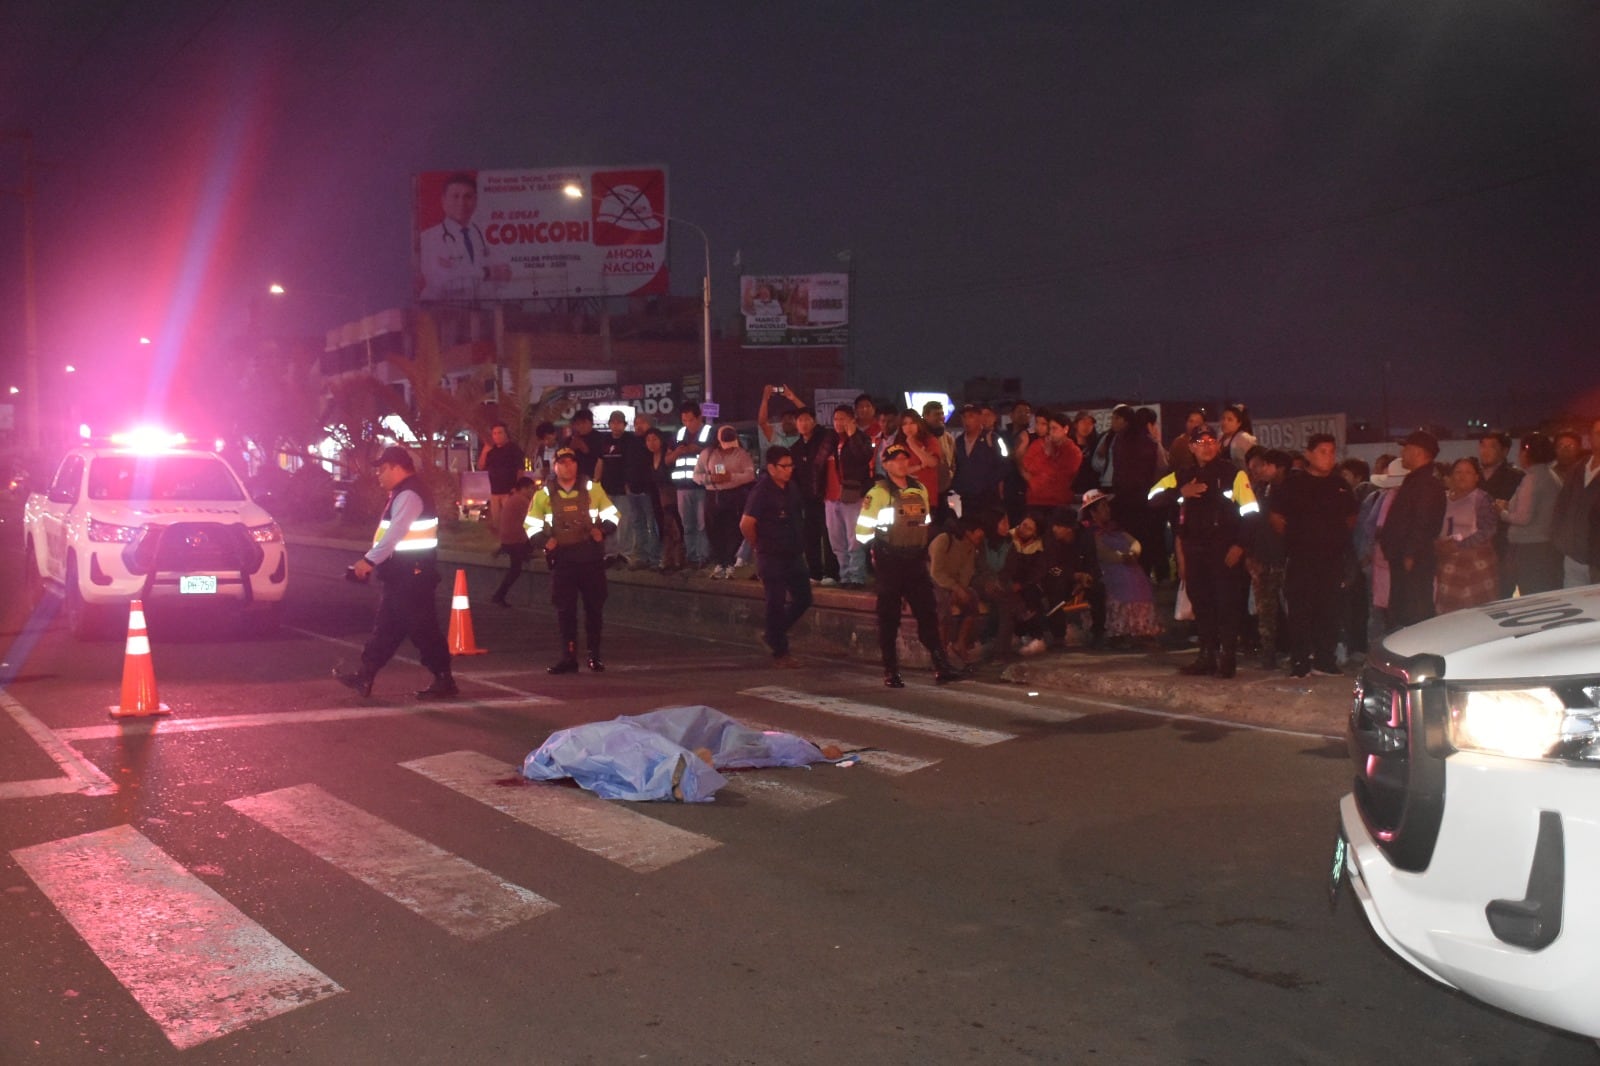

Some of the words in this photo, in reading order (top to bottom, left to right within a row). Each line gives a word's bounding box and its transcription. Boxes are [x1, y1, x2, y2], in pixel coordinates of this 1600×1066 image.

[485, 221, 589, 245] CONCORI
[606, 248, 653, 259] AHORA
[645, 382, 672, 397] PPF
